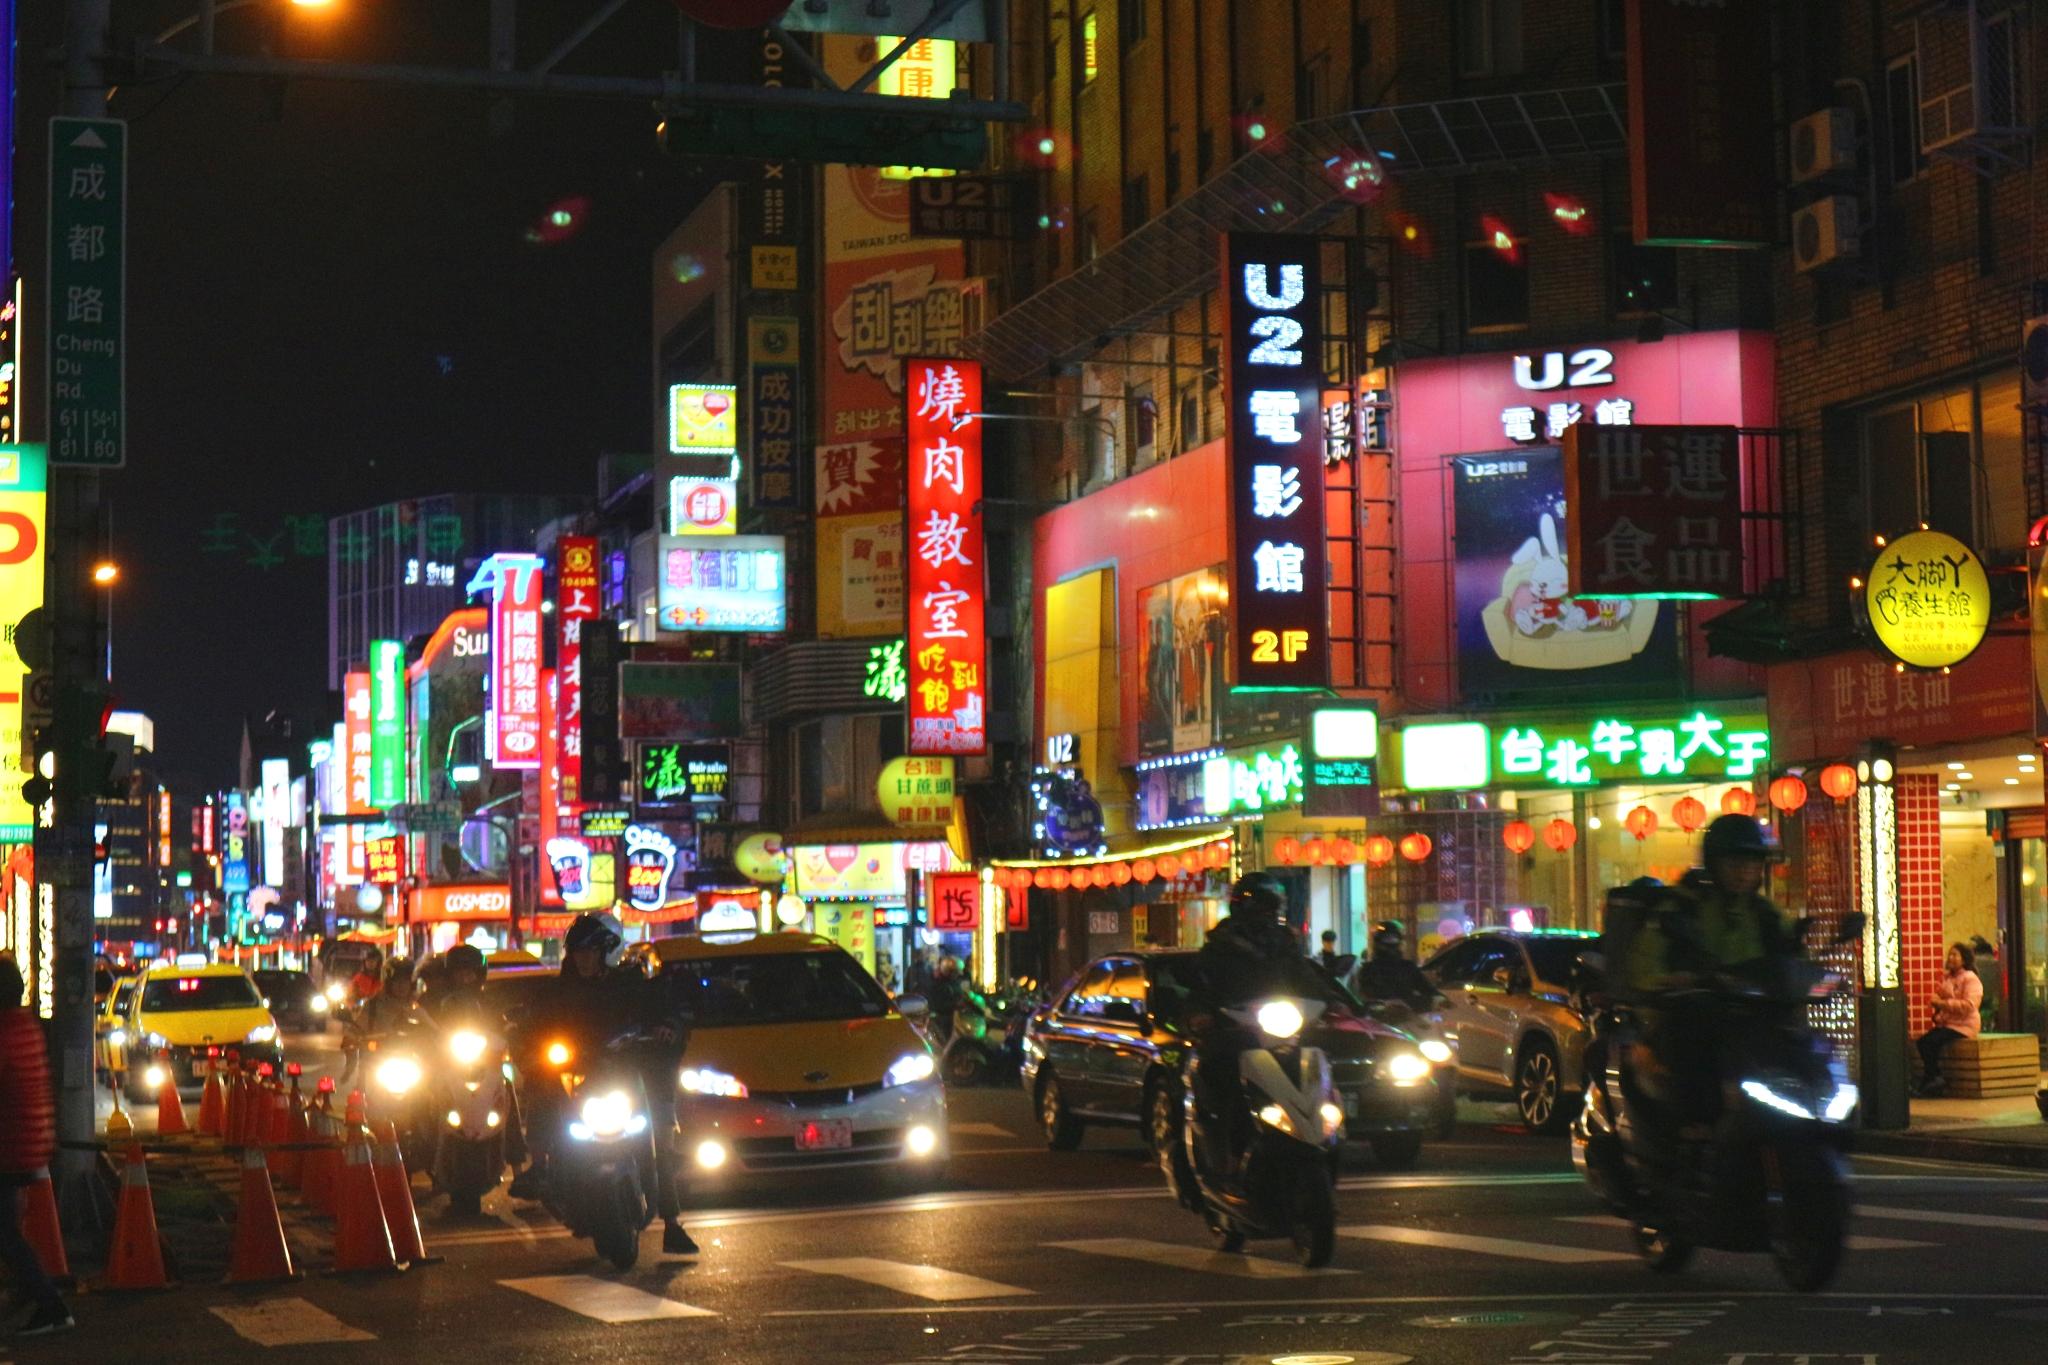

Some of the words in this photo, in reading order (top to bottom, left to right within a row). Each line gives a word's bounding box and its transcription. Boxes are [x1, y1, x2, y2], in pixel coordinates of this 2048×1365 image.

[67, 163, 106, 323] 成都路
[843, 236, 885, 251] TAIWAN
[56, 334, 115, 357] Cheng
[56, 358, 82, 376] Du
[1512, 349, 1616, 390] U2
[59, 408, 78, 426] 61
[60, 440, 78, 456] 81
[758, 374, 792, 499] 成功按摩
[1590, 431, 1728, 499] 世運
[918, 365, 973, 639] 燒肉教室
[1595, 516, 1731, 585] 食品
[1251, 630, 1309, 662] 2F
[1048, 733, 1073, 763] U2
[1501, 711, 1768, 784] 台北牛乳大王
[1233, 743, 1304, 810] 台北牛乳大
[628, 865, 662, 886] 200
[445, 893, 506, 912] COSMED
